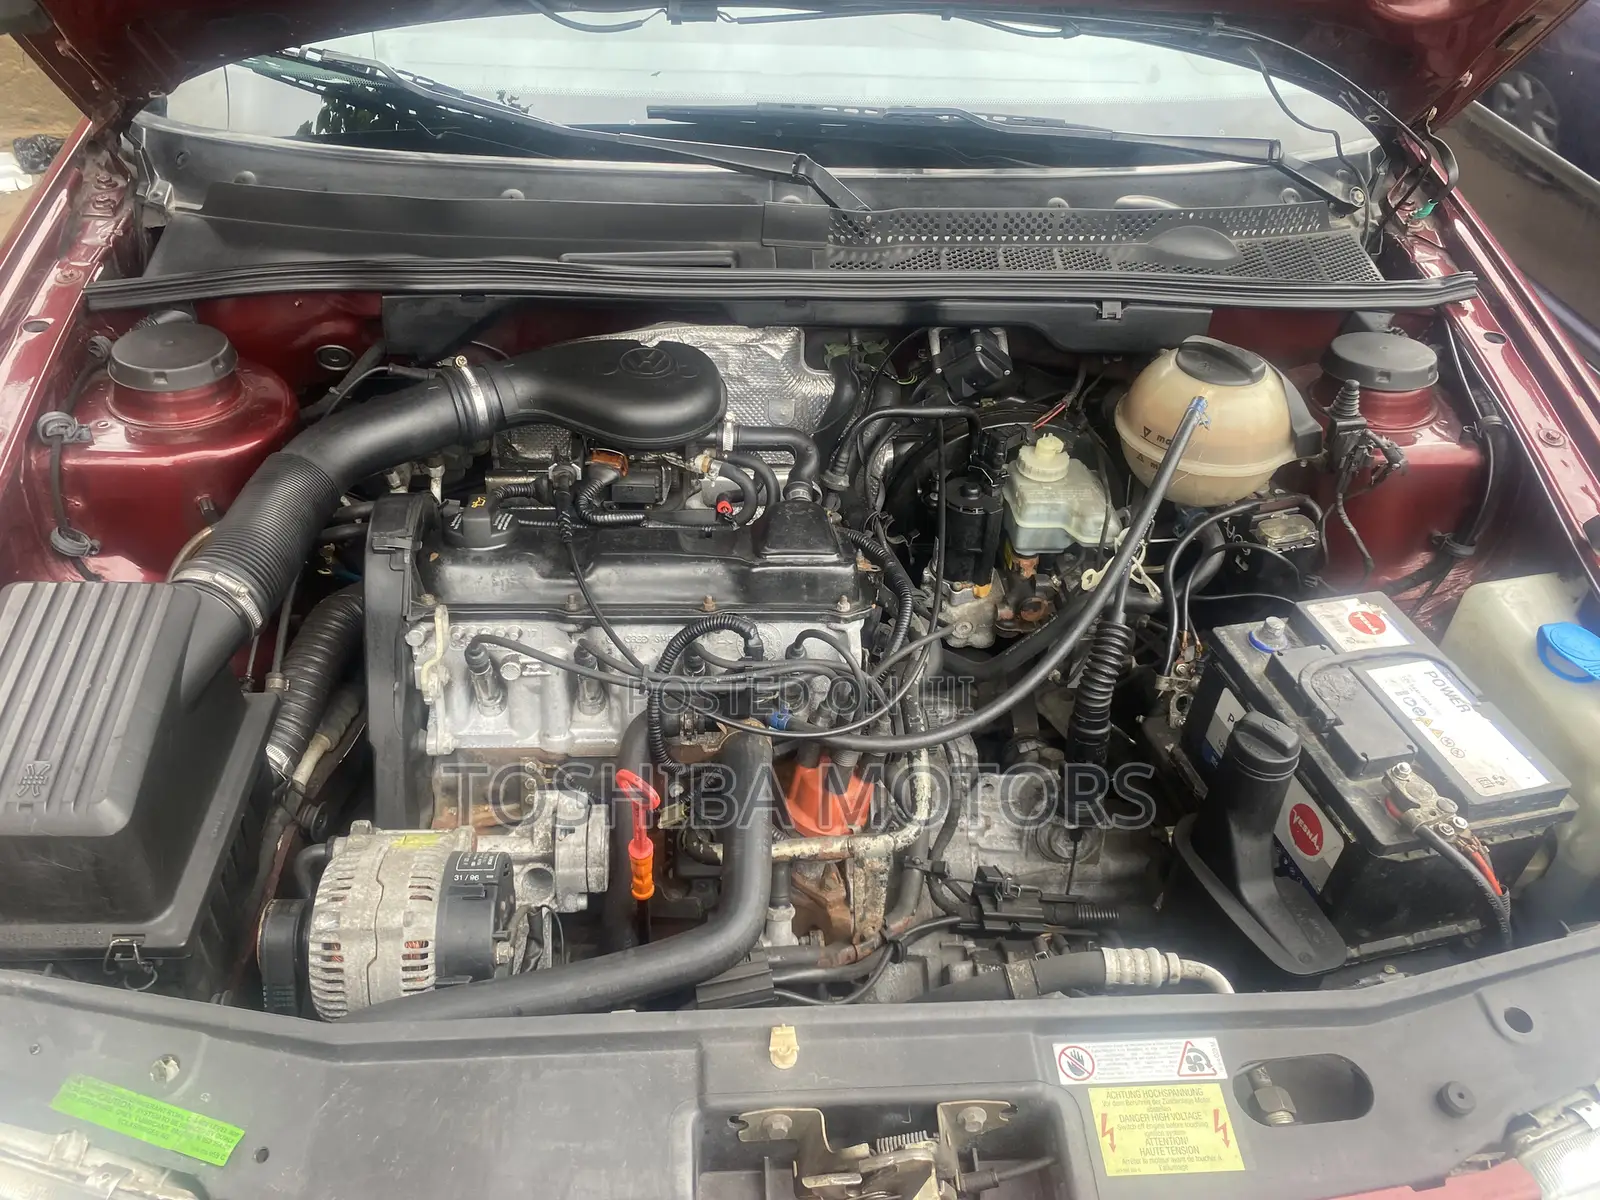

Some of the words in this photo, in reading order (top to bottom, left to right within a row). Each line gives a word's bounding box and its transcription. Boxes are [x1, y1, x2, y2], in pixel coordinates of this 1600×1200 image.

[1424, 671, 1471, 712] POWER
[1292, 809, 1319, 851] VESNA
[1106, 1090, 1141, 1099] ACHTUNG
[1142, 1088, 1203, 1097] HOCHSPANNUNG
[1119, 1113, 1149, 1122] DANGER
[1171, 1111, 1202, 1120] VOLTAGE
[1144, 1136, 1189, 1146] ATTENTION!
[1139, 1147, 1165, 1156] HAUTE
[1166, 1145, 1200, 1155] TENSION
